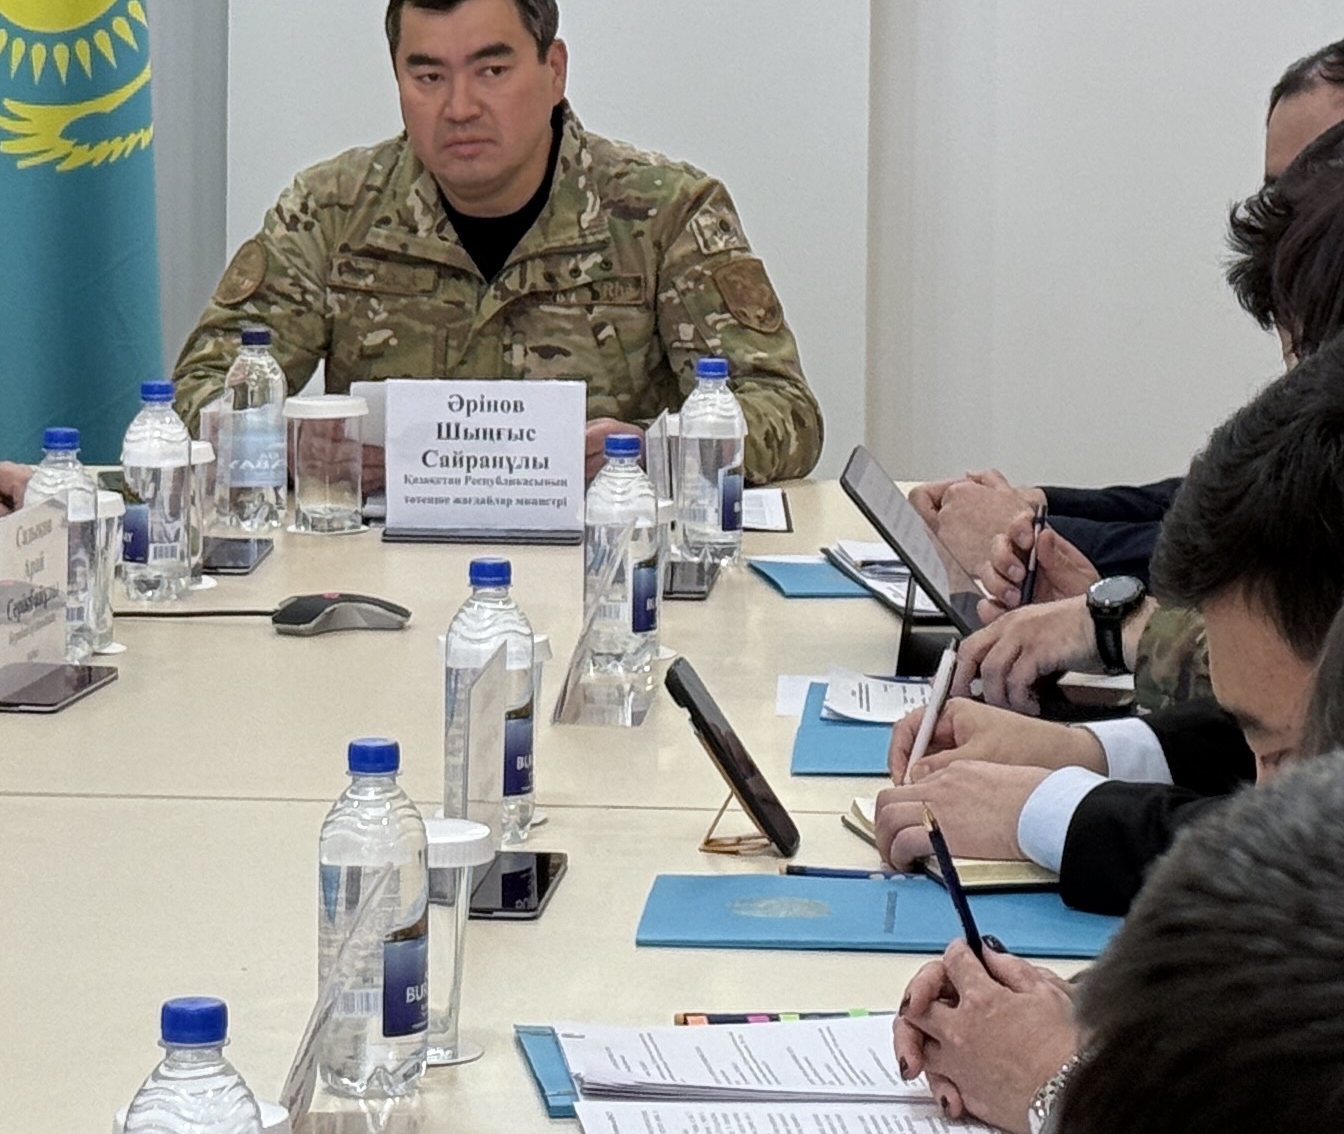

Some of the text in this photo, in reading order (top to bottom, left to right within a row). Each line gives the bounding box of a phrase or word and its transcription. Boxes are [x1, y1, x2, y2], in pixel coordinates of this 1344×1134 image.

[447, 393, 525, 417] Әрінов
[436, 422, 537, 444] Шыңғыс
[421, 449, 549, 474] Сайранұлы
